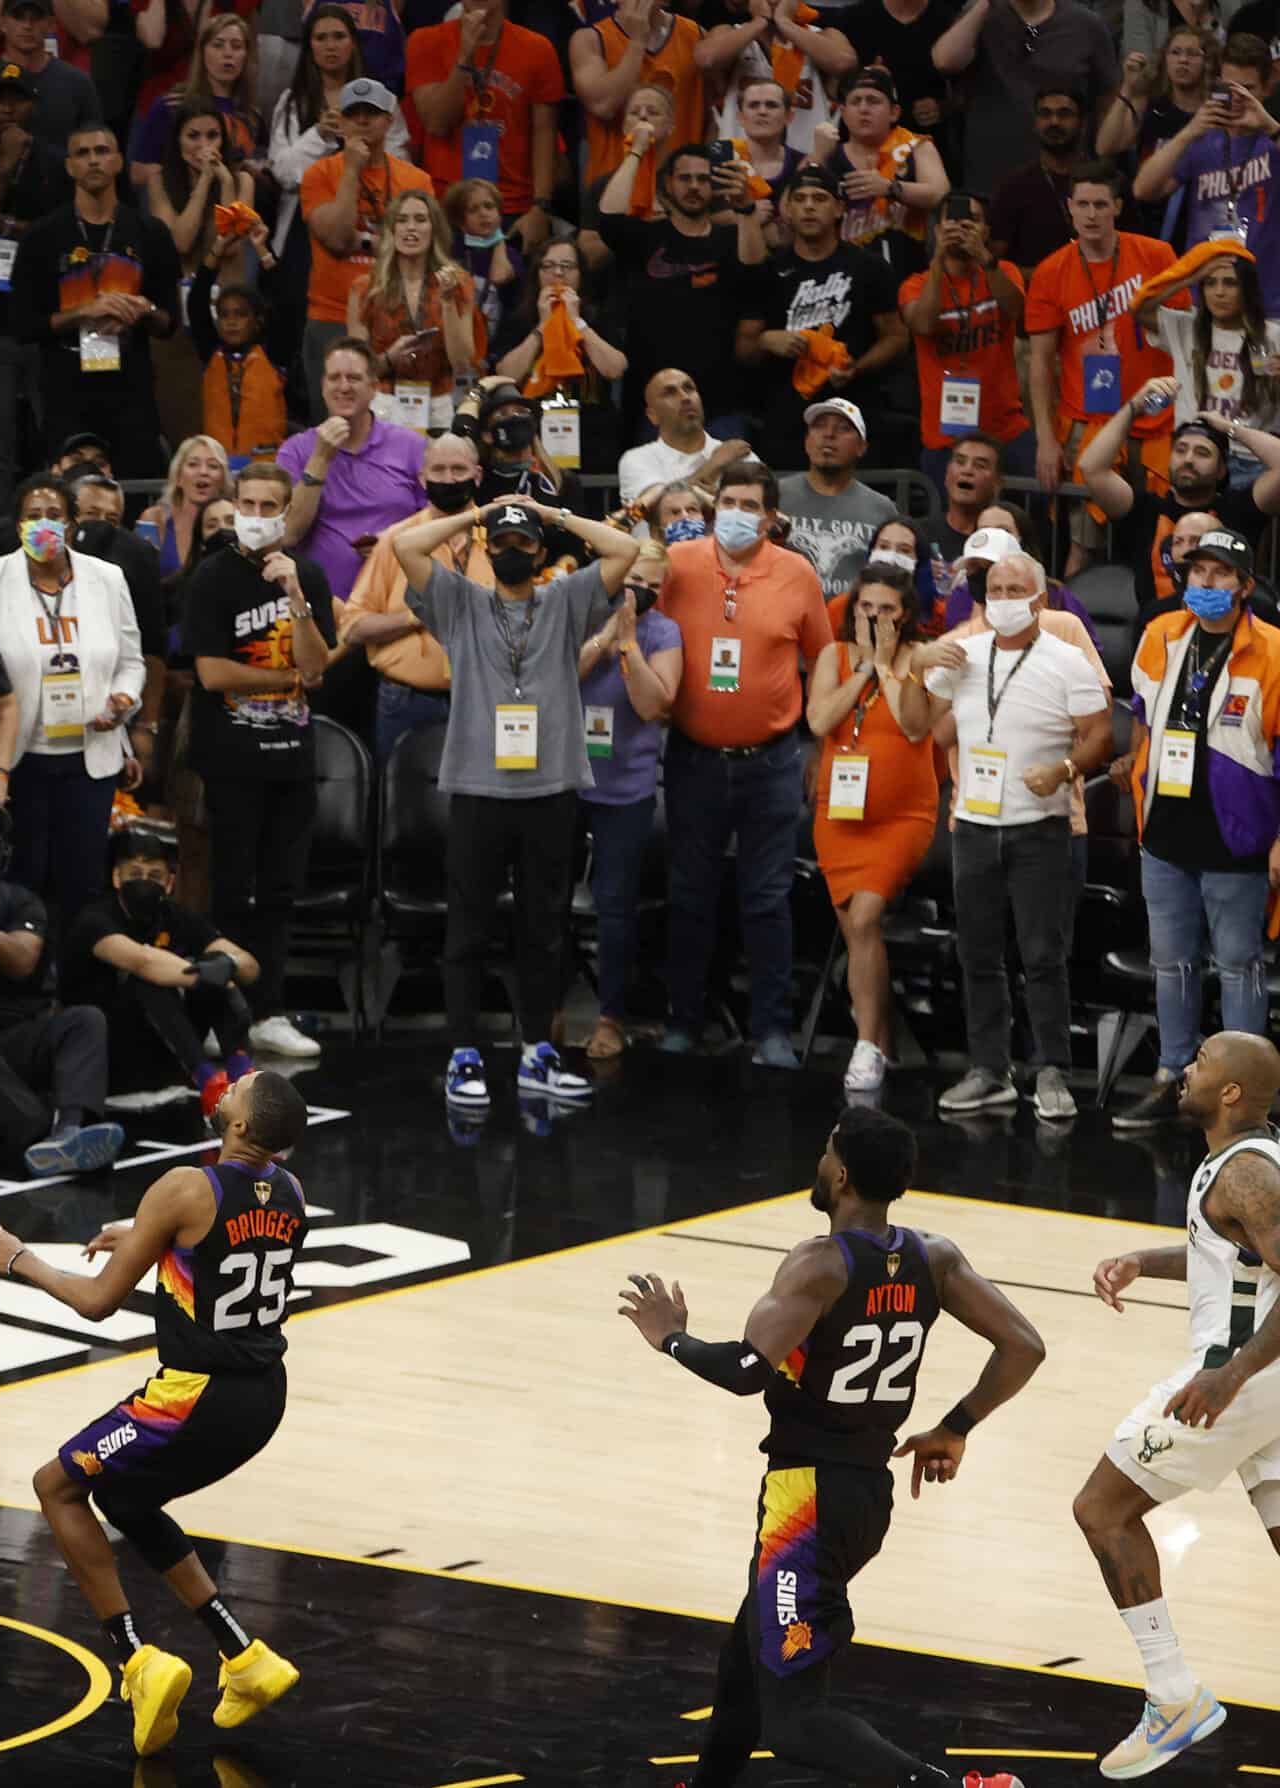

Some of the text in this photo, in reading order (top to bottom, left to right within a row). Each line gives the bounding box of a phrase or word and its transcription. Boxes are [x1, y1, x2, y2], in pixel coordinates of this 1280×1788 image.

[225, 1208, 301, 1247] BRIDGES
[213, 1248, 293, 1331] 25
[866, 1283, 916, 1317] AYTON
[827, 1321, 924, 1404] 22
[97, 1421, 137, 1460] SUNS
[777, 1570, 798, 1626] SUNS
